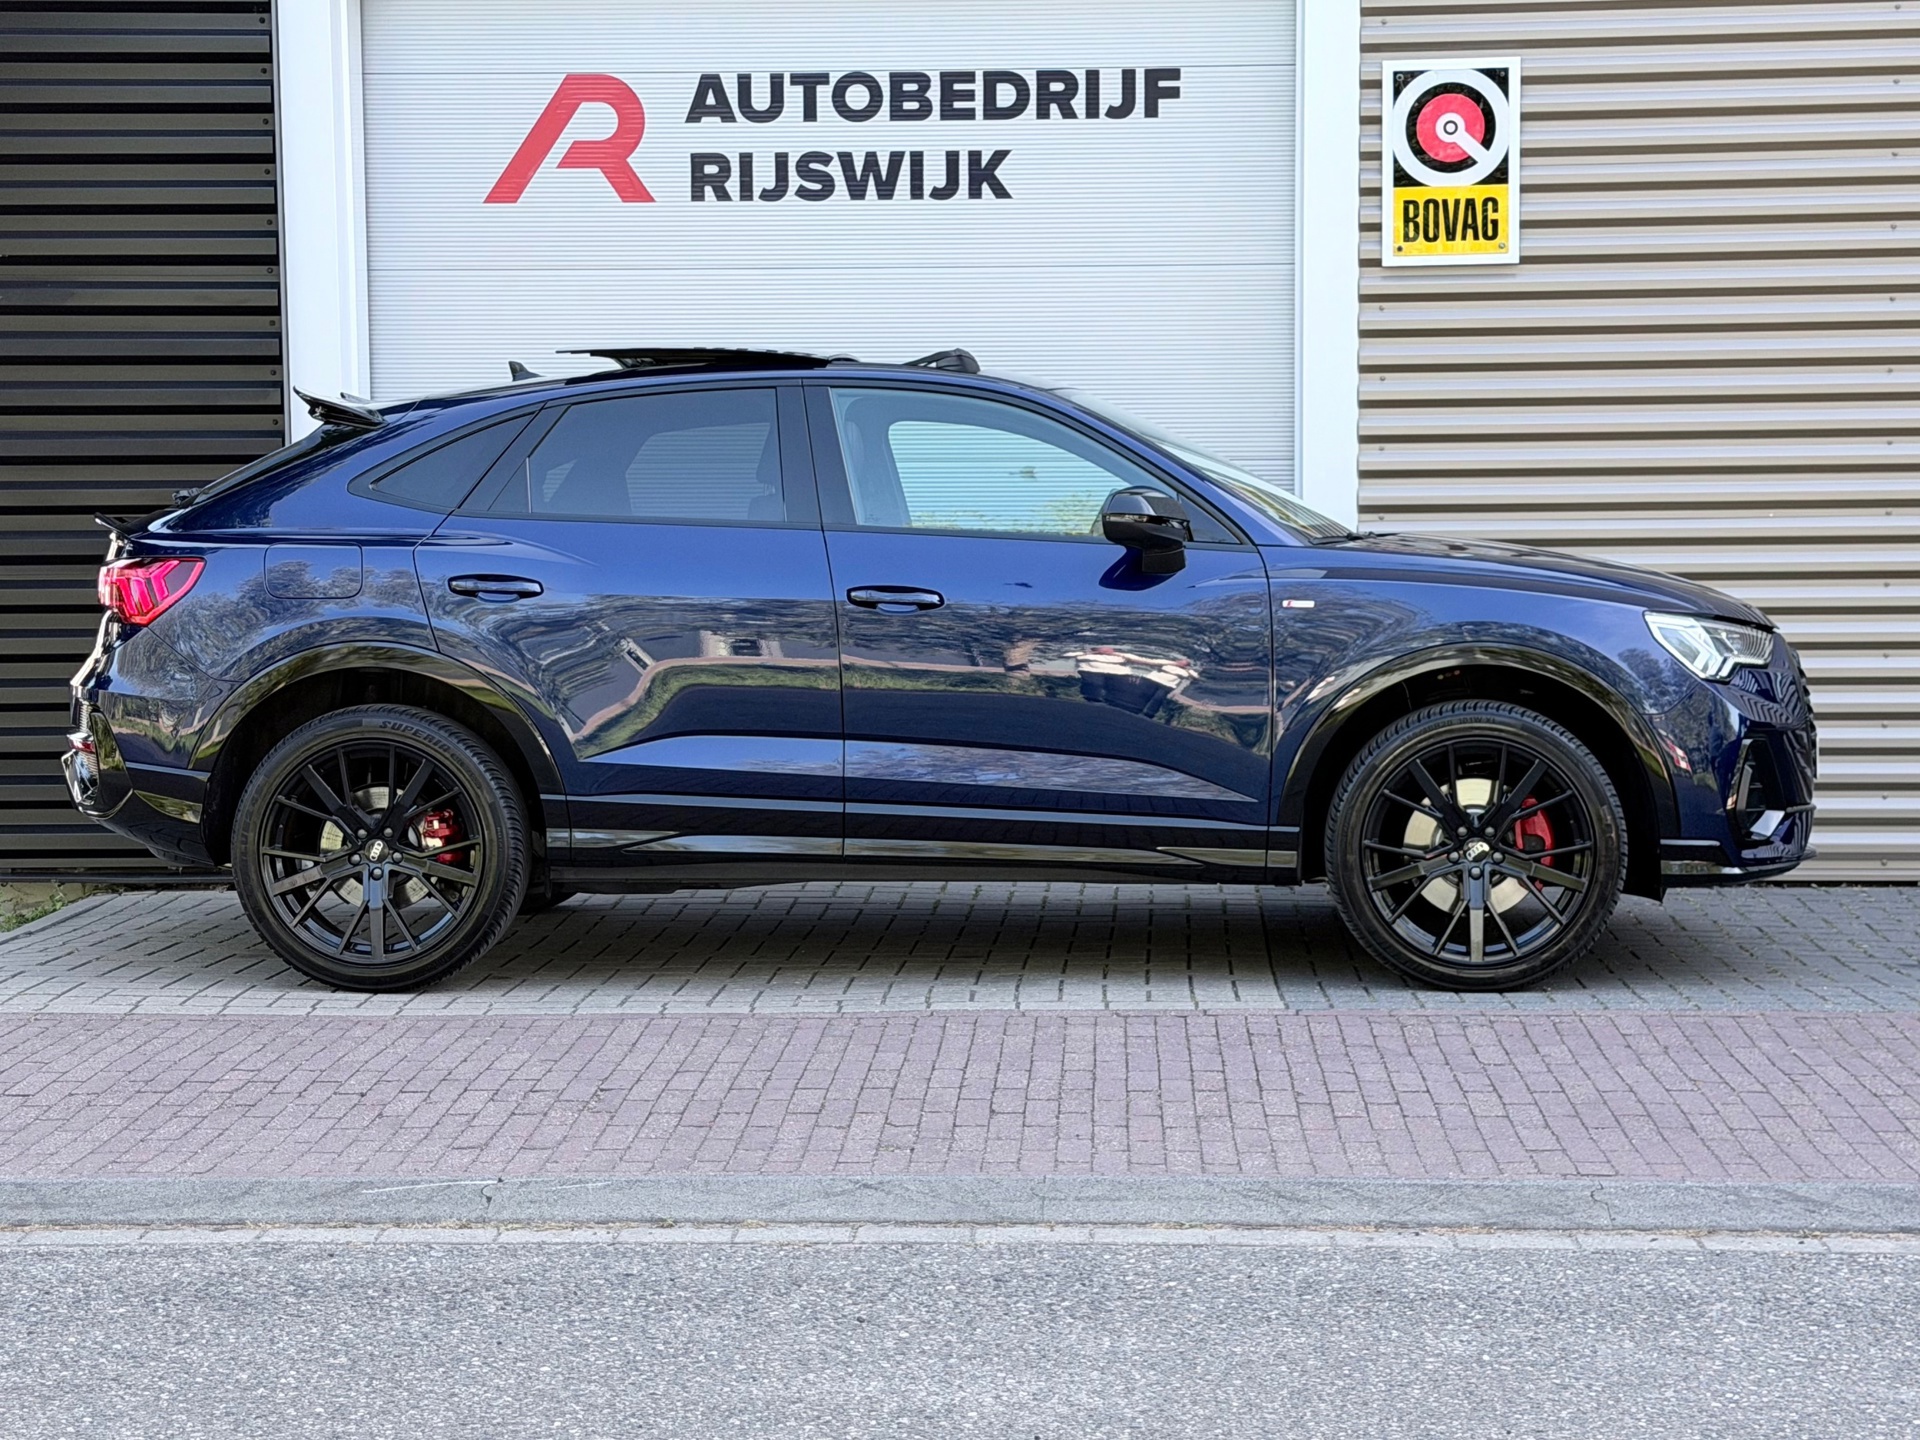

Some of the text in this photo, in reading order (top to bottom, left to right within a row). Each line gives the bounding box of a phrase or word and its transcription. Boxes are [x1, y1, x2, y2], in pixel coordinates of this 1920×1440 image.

[685, 68, 1181, 124] AUTOBEDRIJF
[690, 149, 1014, 202] RIJSWIJK
[1403, 197, 1499, 242] BOVAG
